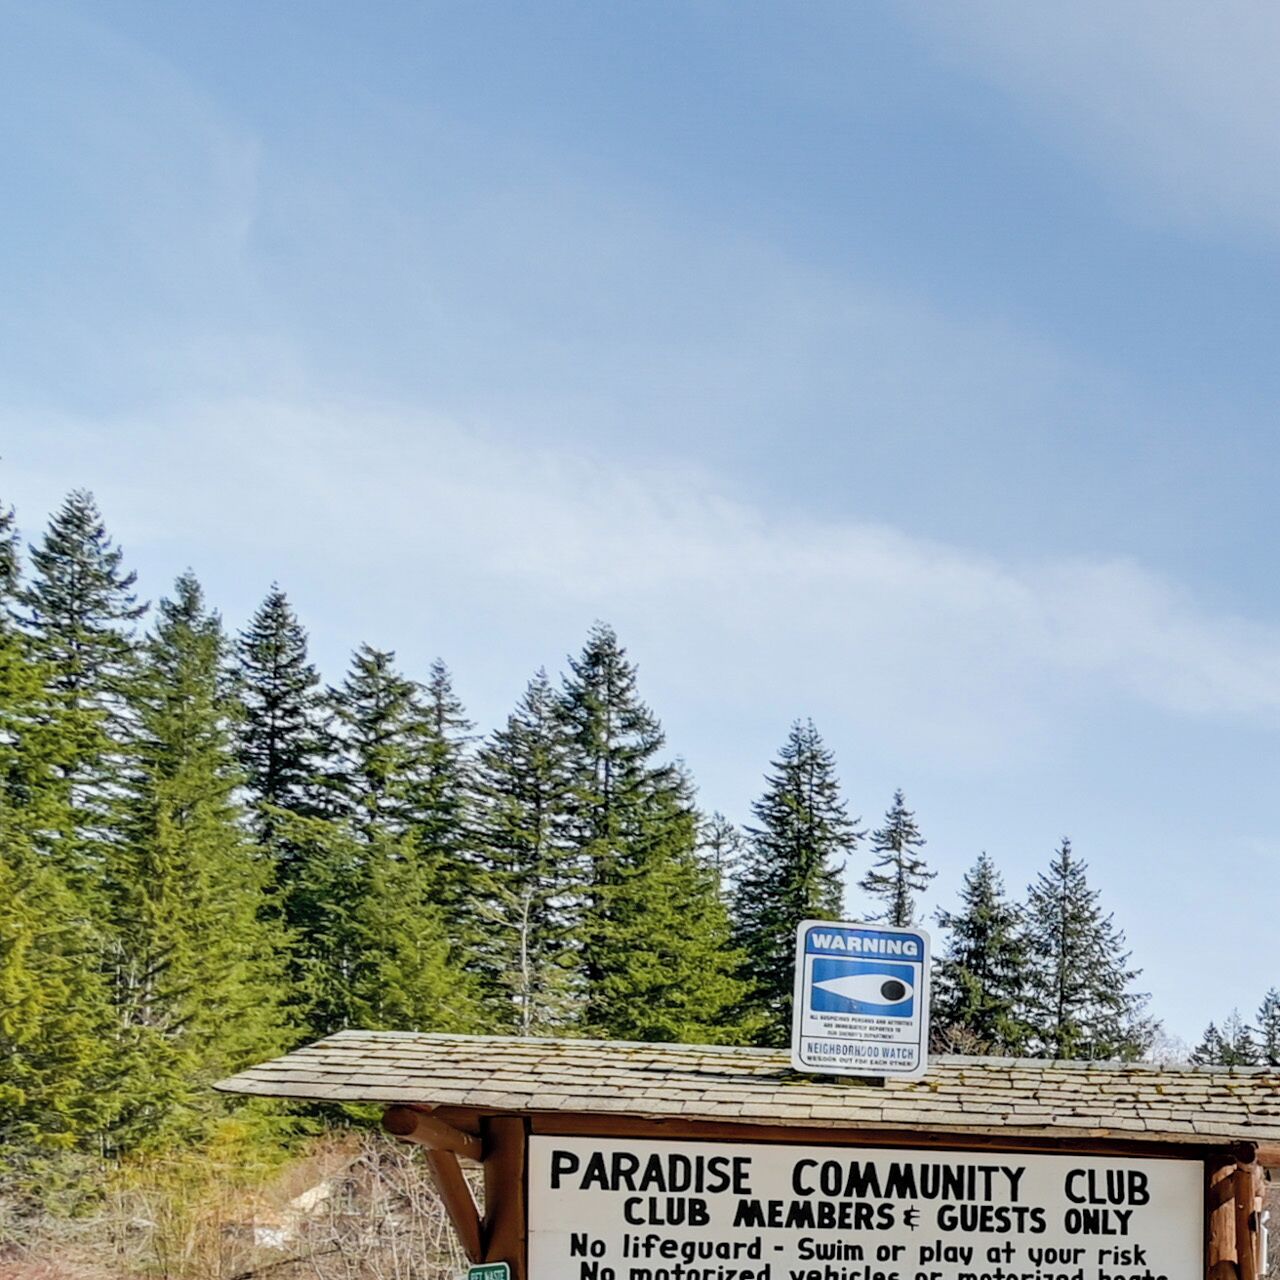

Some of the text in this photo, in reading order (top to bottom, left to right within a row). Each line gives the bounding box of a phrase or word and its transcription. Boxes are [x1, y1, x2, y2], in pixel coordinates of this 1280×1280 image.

[812, 933, 918, 956] WARNING
[807, 1042, 914, 1059] NEIGHBORHOOD WATCH
[550, 1150, 1150, 1206] PARADISE COMMUNITY CLUB
[623, 1196, 711, 1227] CLUB
[732, 1198, 895, 1231] MEMBERS
[936, 1203, 1047, 1234] GUESTS
[1064, 1208, 1134, 1236] ONLY
[570, 1232, 606, 1258] No
[622, 1233, 762, 1265] lifeguard
[797, 1237, 864, 1261] Swim
[876, 1244, 906, 1262] or
[919, 1239, 974, 1266] play
[986, 1240, 1016, 1264] at
[1027, 1247, 1086, 1268] your
[1098, 1243, 1147, 1266] risk
